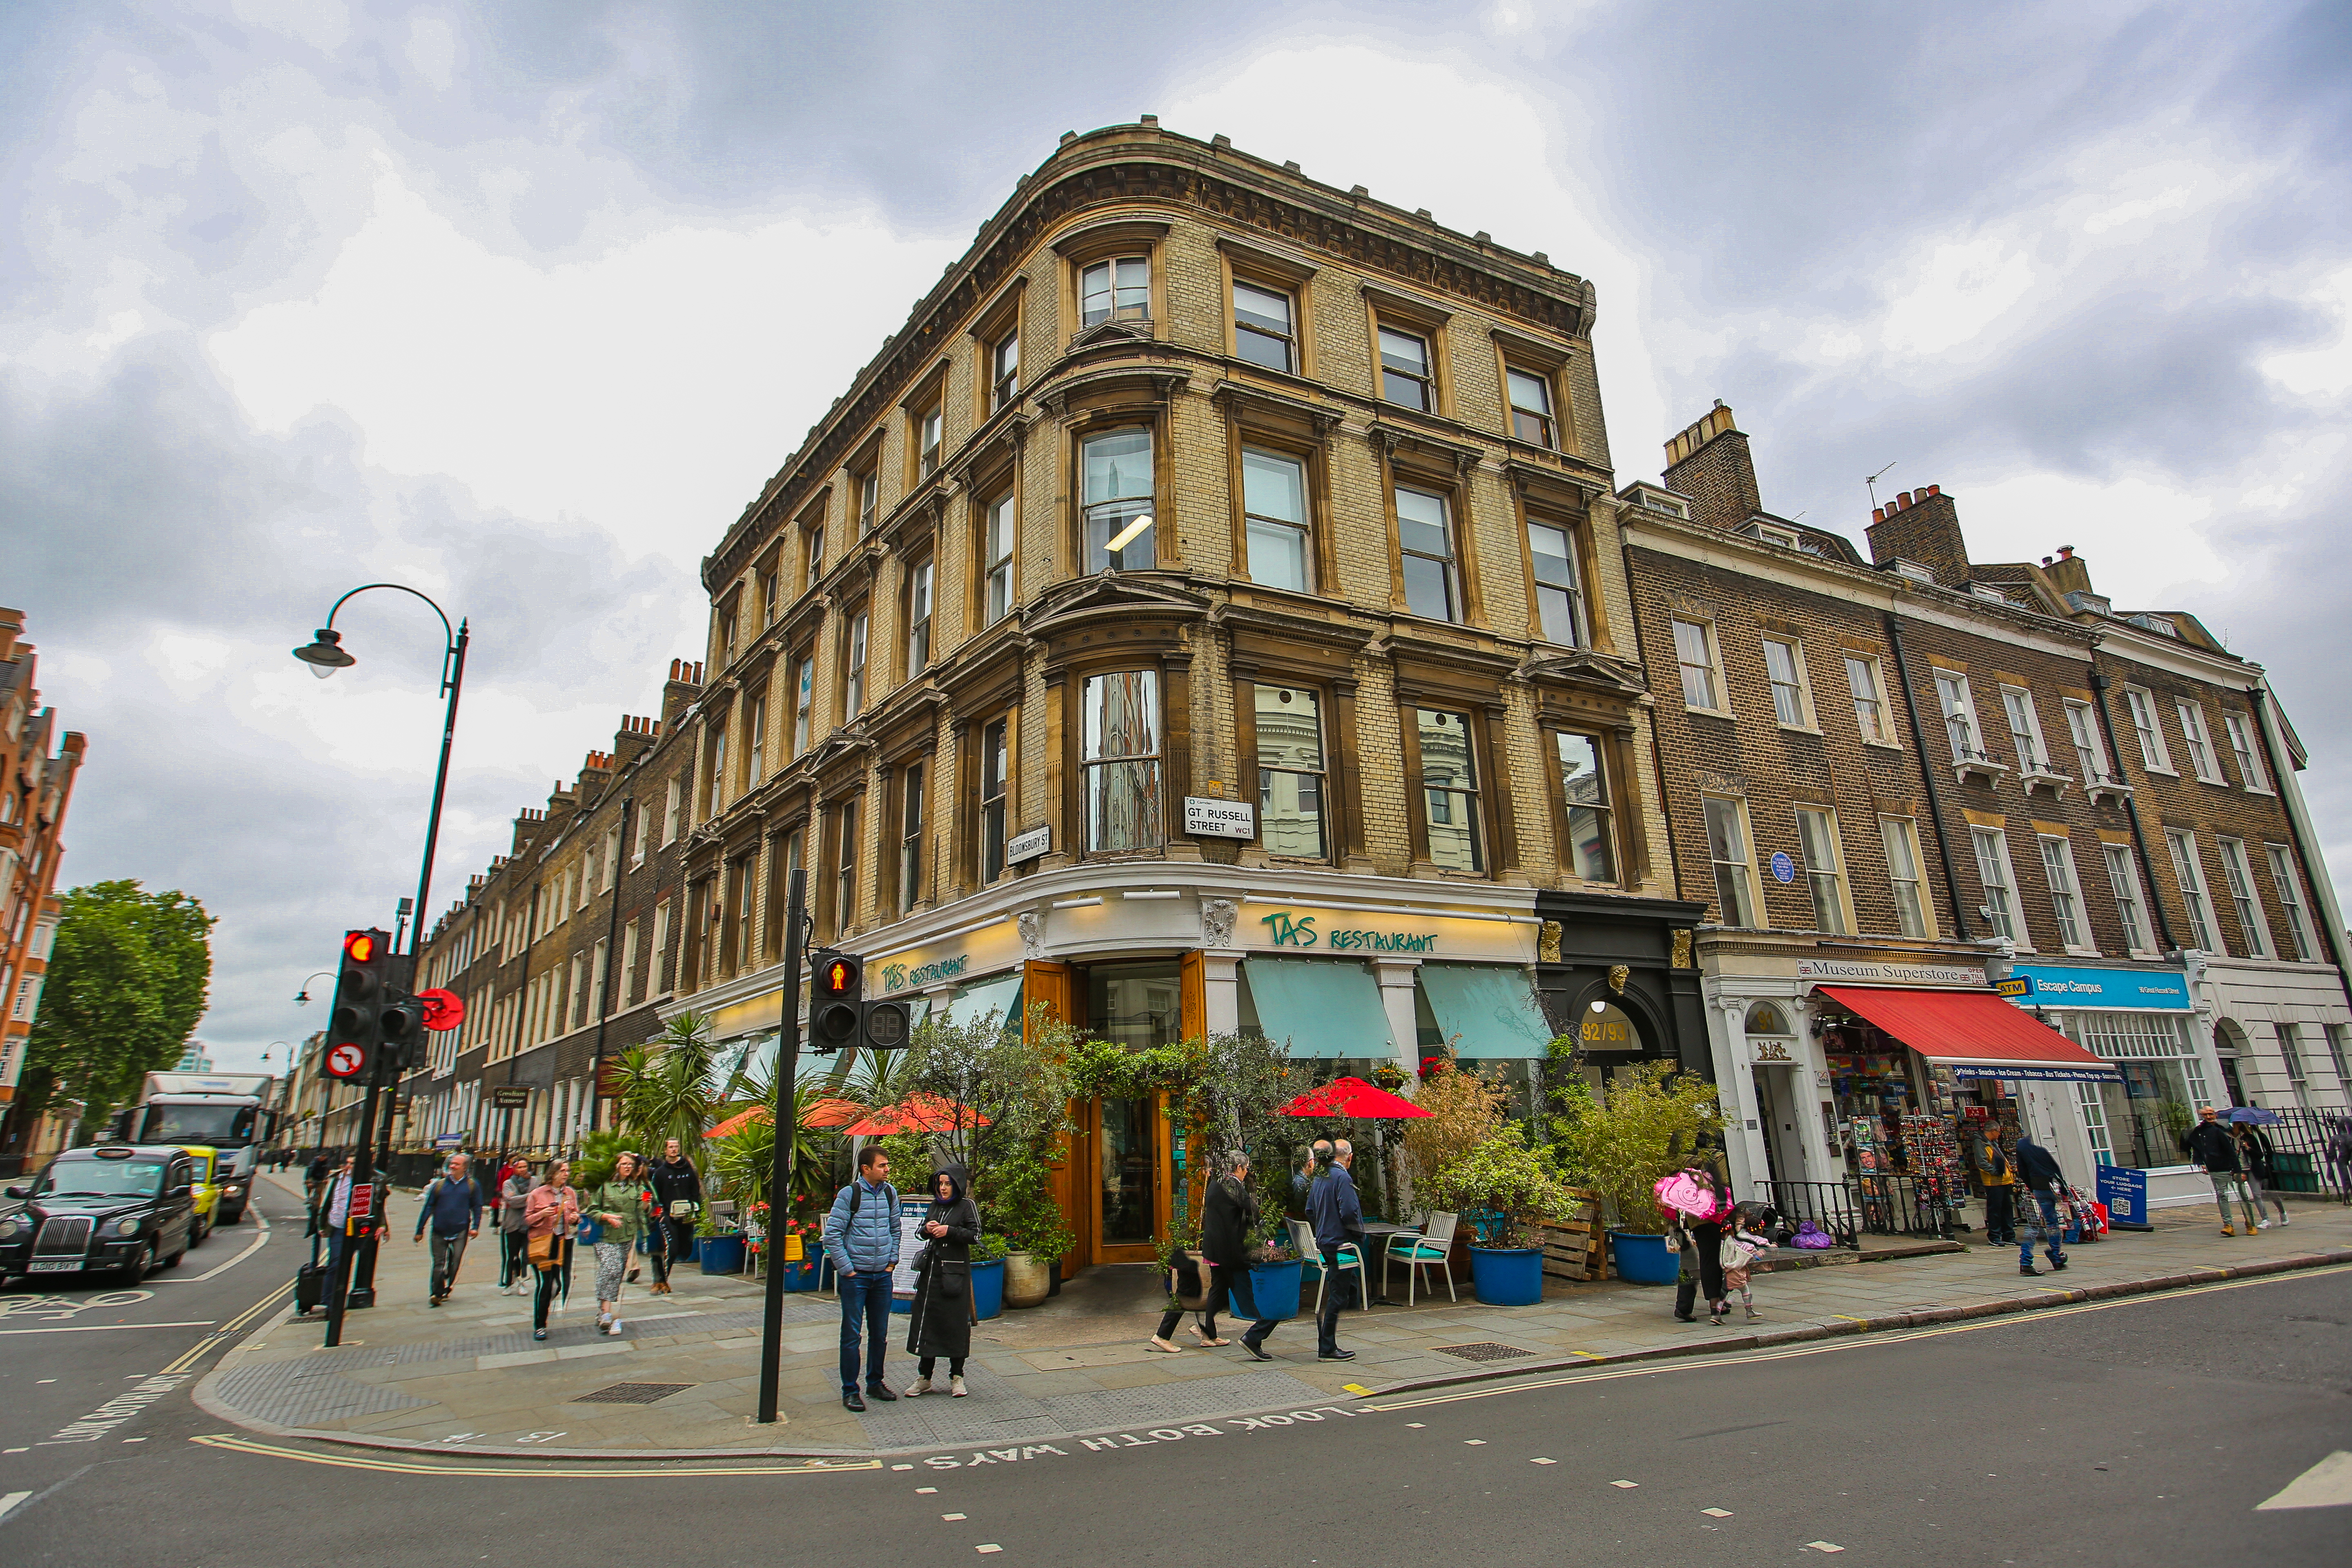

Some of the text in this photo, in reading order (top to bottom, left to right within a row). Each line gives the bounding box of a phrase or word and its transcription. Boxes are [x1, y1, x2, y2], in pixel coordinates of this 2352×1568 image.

[1188, 807, 1251, 822] GT. RUSSELL
[1189, 820, 1226, 832] STREET
[1009, 836, 1040, 857] BLOOMSBURY
[1262, 911, 1438, 952] TAS RESTAURANT
[882, 954, 969, 992] TAS RESTAURANT
[1812, 962, 1958, 981] Museum Superstore
[2001, 983, 2022, 993] ATM
[2036, 979, 2103, 995] Escape Campus
[1757, 1010, 1774, 1030] 91
[1582, 1022, 1626, 1041] 92/93
[79, 1393, 166, 1420] BOTH
[34, 1418, 129, 1446] LOOK
[923, 1406, 1356, 1470] LOOK BOTH WAYS
